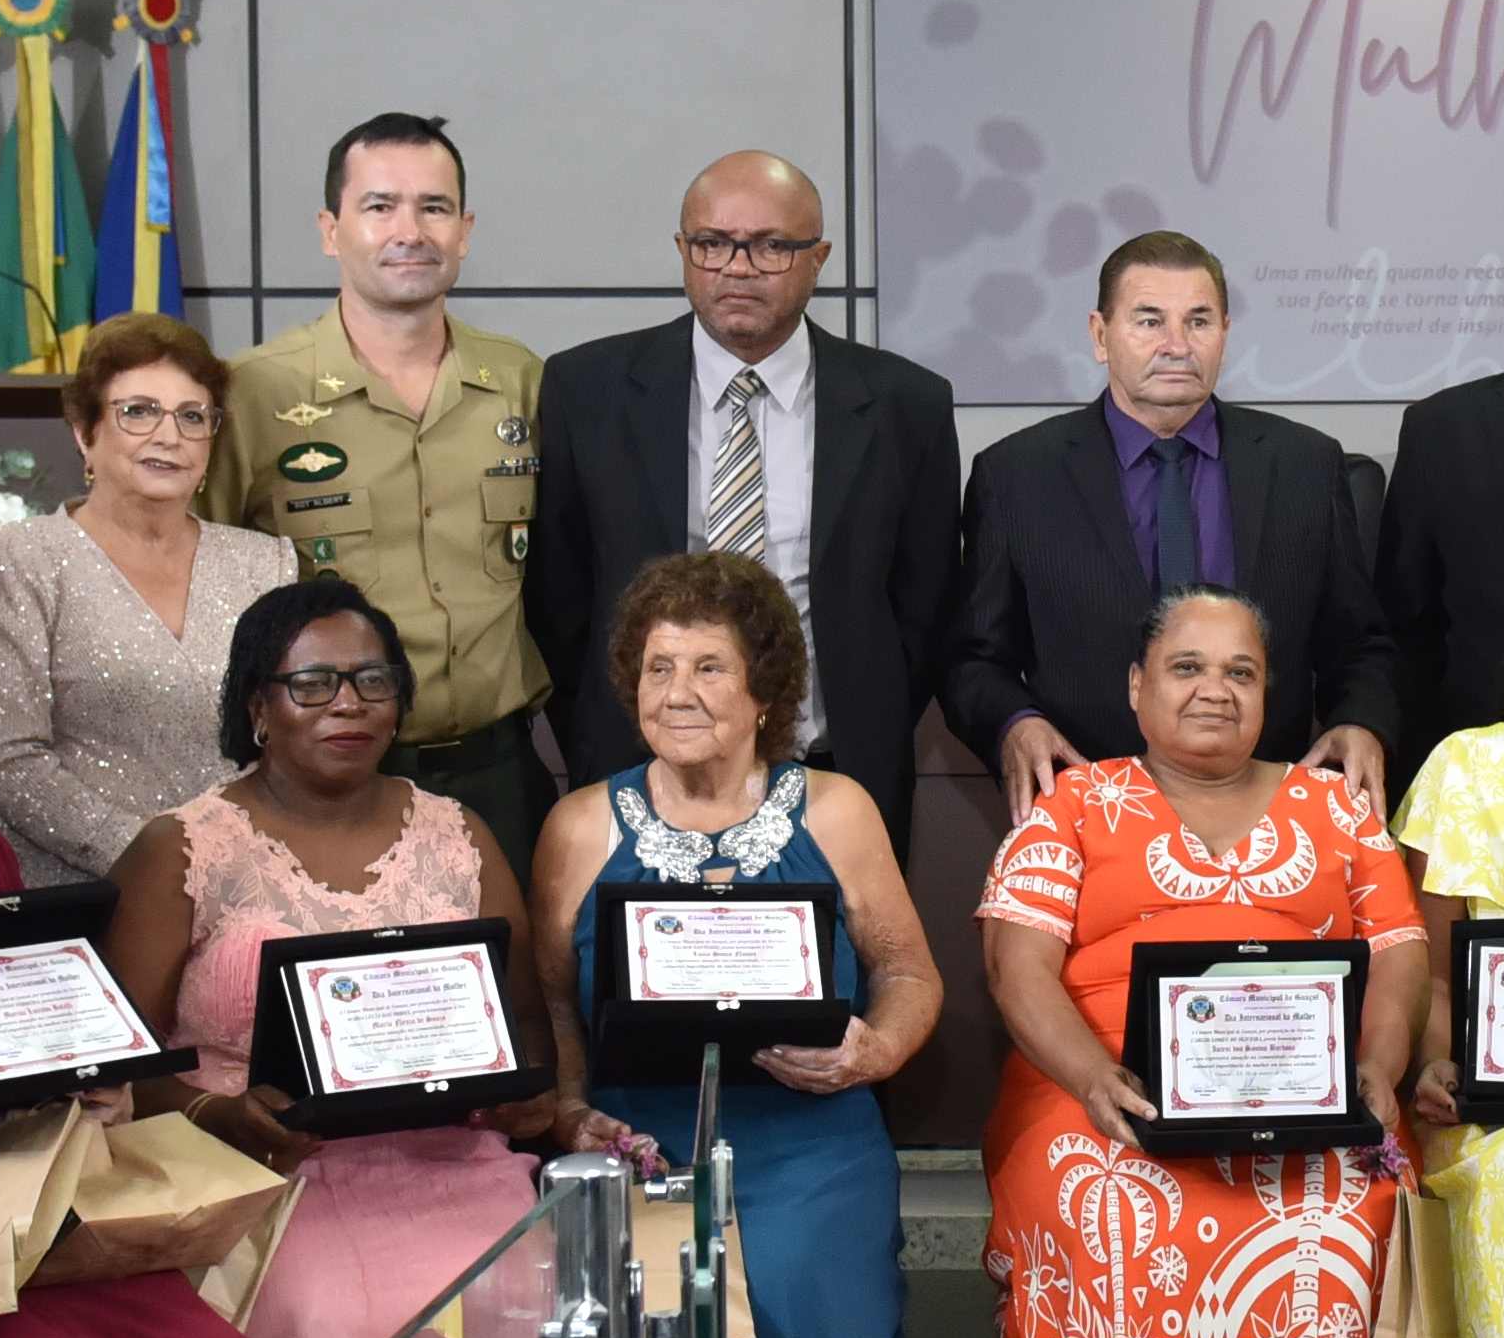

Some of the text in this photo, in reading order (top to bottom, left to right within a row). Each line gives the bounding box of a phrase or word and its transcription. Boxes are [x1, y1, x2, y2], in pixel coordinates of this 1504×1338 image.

[1254, 265, 1301, 281] Uma
[1386, 263, 1460, 284] quando
[1277, 293, 1311, 309] sua
[1315, 290, 1372, 313] força,
[1377, 293, 1400, 309] se
[1404, 291, 1460, 309] torna
[1310, 316, 1424, 338] inesgotável
[1428, 316, 1454, 335] de
